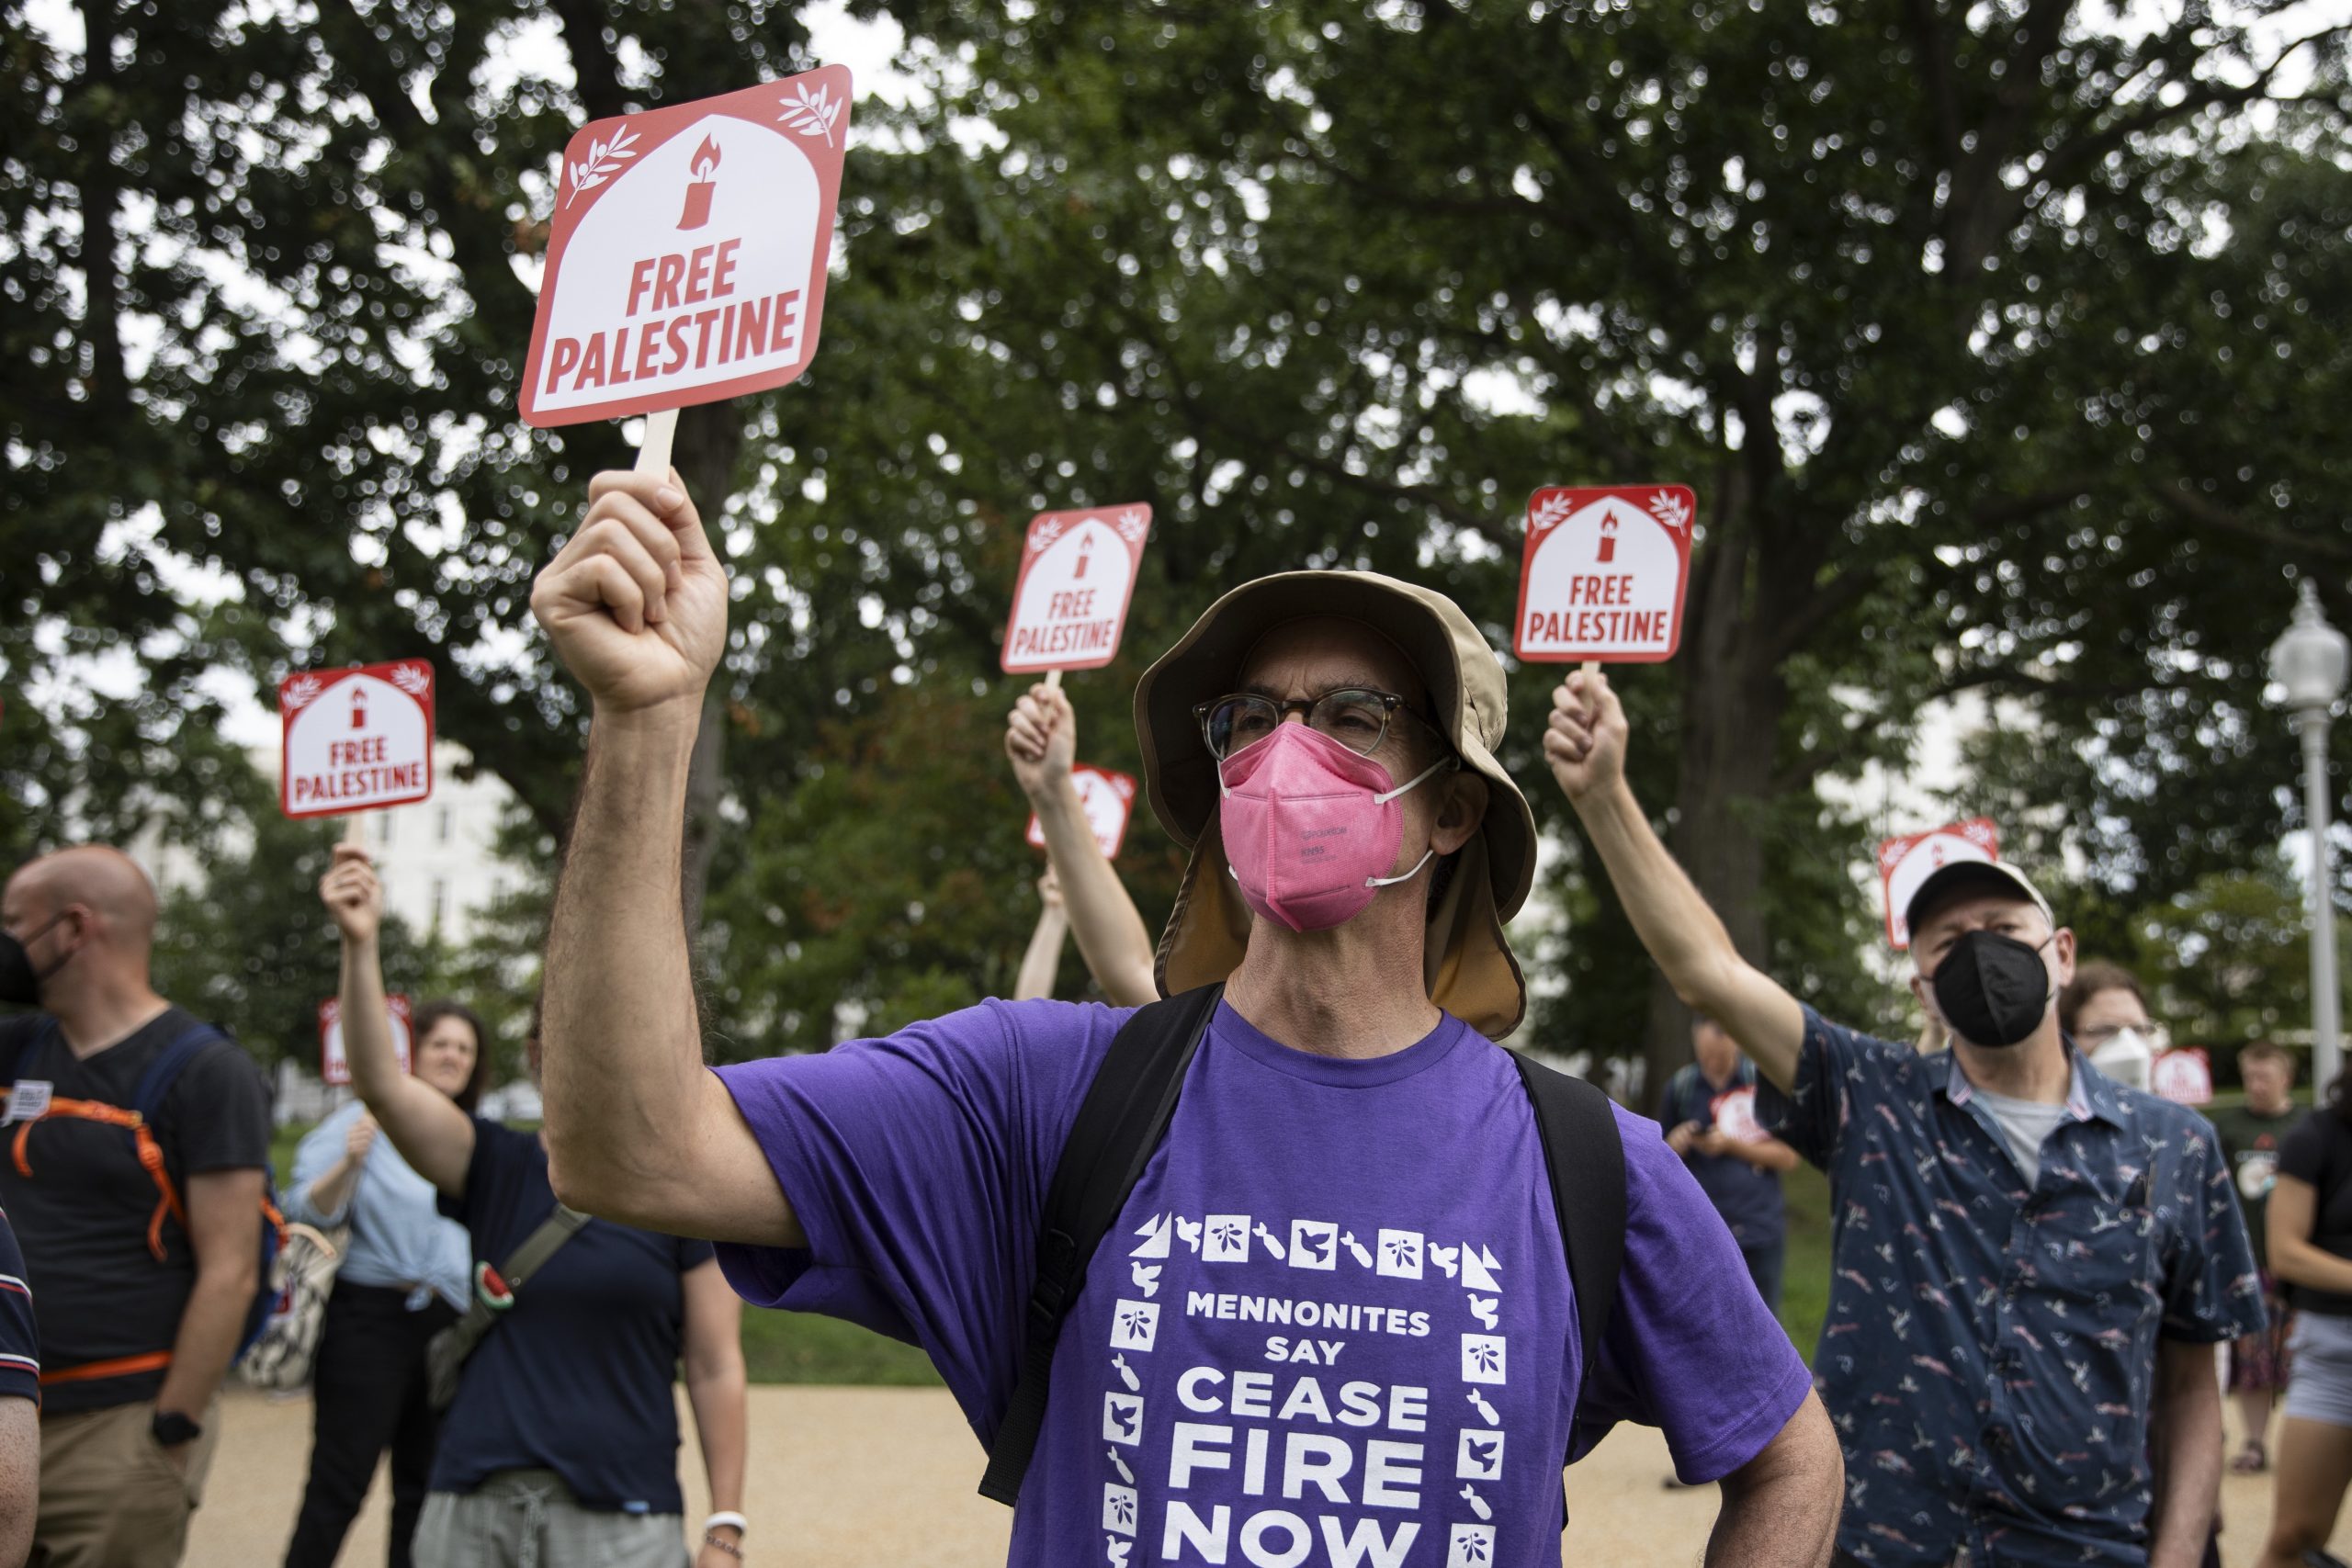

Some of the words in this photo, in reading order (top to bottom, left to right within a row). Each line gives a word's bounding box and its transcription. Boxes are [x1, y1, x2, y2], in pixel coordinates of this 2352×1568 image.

[626, 237, 742, 318] FREE
[545, 288, 801, 396] PALESTINE
[1047, 589, 1097, 620] FREE
[1568, 574, 1634, 606] FREE
[1013, 619, 1114, 657] PALESTINE
[1527, 611, 1668, 643] PALESTINE
[330, 736, 387, 767] FREE
[294, 761, 422, 803] PALESTINE
[1186, 1291, 1431, 1337] MENNONITES
[1264, 1336, 1346, 1367] SAY
[1176, 1366, 1429, 1433] CEASE
[1168, 1421, 1425, 1510] FIRE
[1160, 1500, 1422, 1568] NOW
